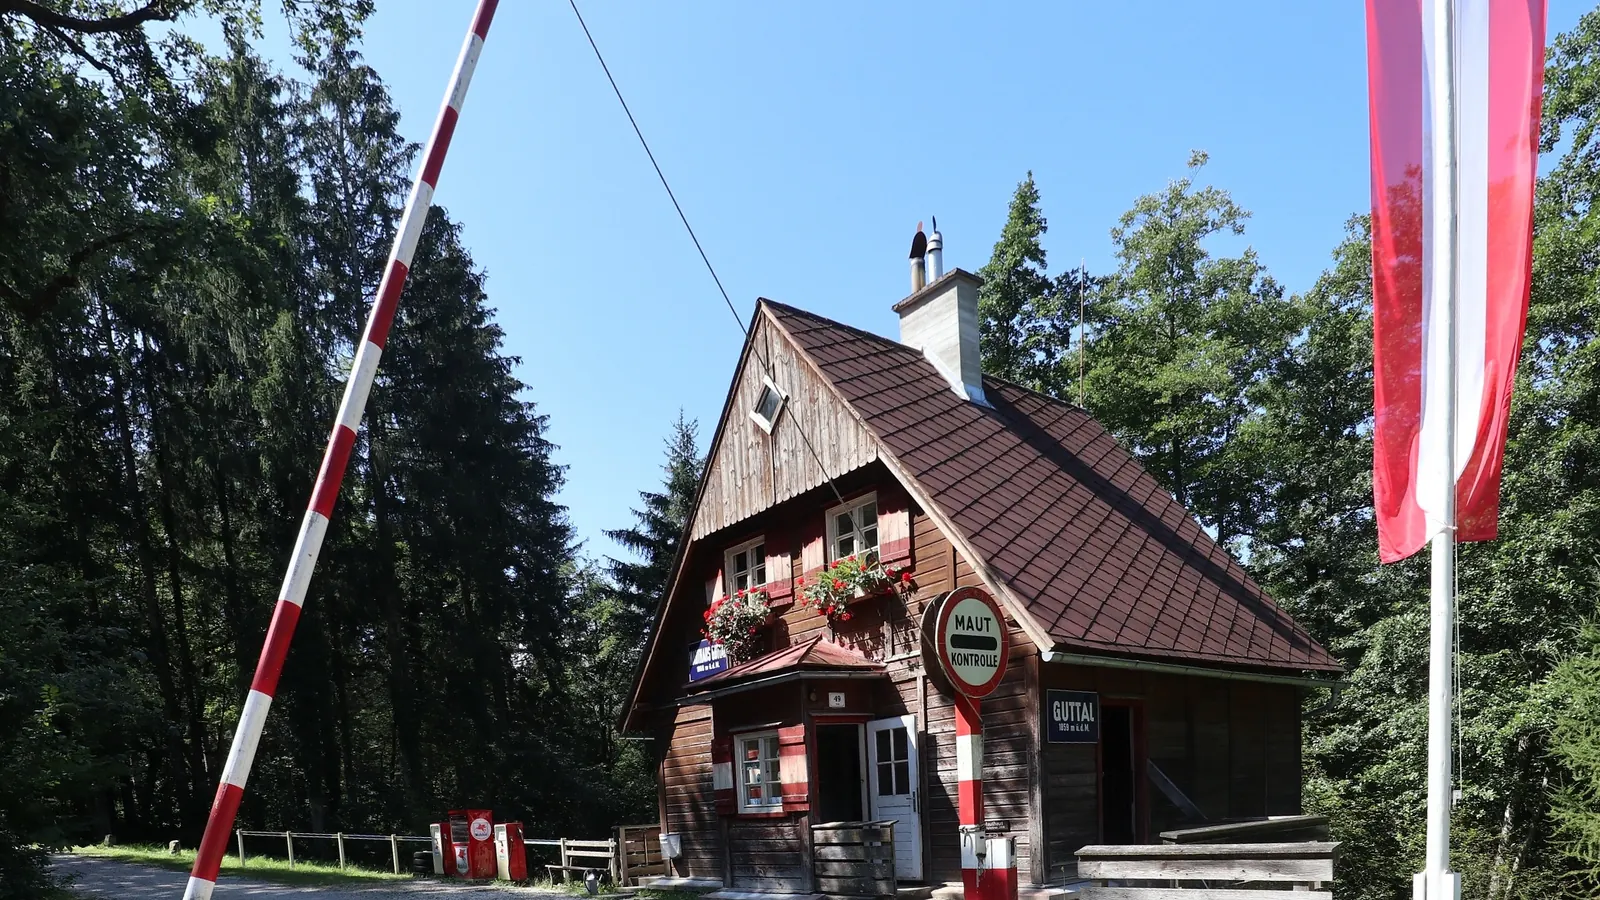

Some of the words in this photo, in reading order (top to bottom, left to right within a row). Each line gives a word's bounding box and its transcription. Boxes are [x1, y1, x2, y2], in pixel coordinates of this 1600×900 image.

[954, 614, 992, 632] MAUT
[950, 652, 998, 668] KONTROLLE
[1053, 700, 1094, 722] GUTTAL
